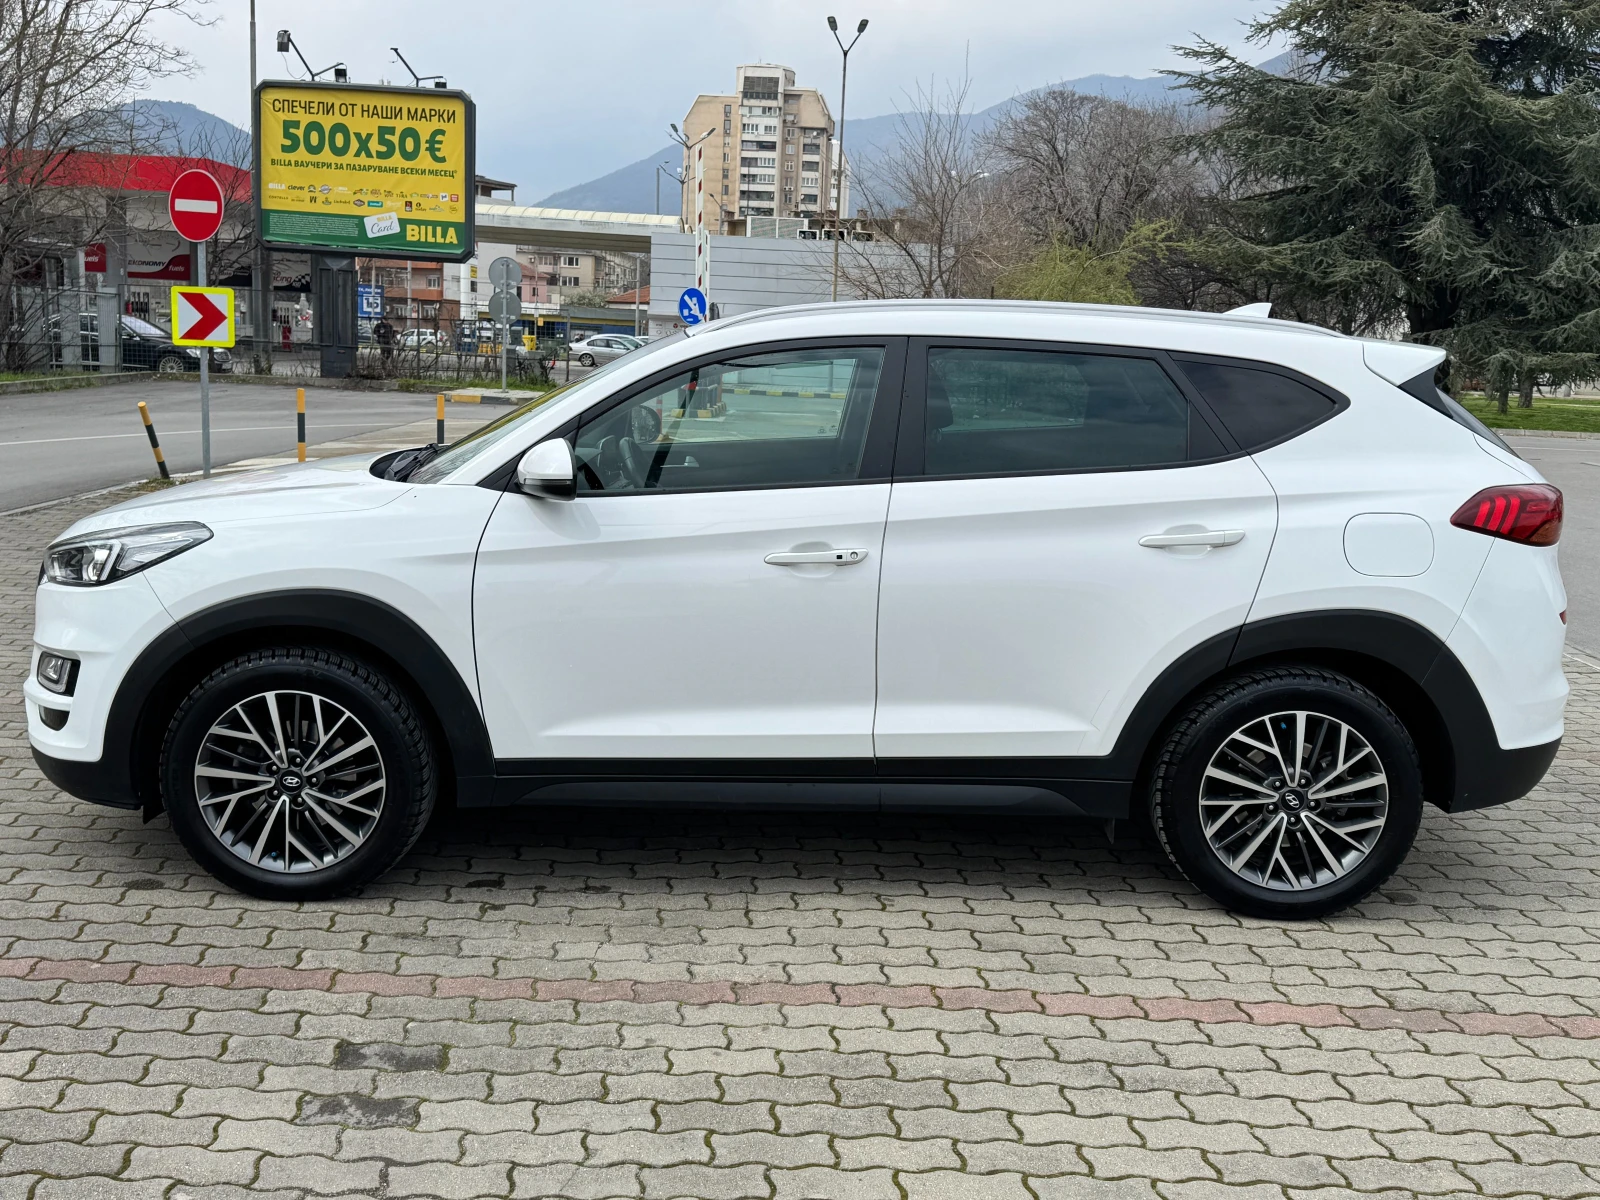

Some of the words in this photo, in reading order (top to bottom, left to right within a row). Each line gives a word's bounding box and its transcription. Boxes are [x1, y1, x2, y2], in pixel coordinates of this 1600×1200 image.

[272, 98, 335, 117] СПЕЧЕЛИ
[338, 102, 357, 118] ОТ
[361, 104, 403, 121] НАШИ
[407, 107, 456, 124] МАРКИ
[271, 158, 293, 167] BILLA
[294, 160, 332, 170] ВАУЧЕРИ
[333, 162, 344, 171] ЗА
[345, 163, 399, 175] ПАЗАРУВАНЕ
[400, 167, 427, 176] ВСЕКИ
[370, 221, 395, 235] Card
[406, 224, 458, 244] BILLA
